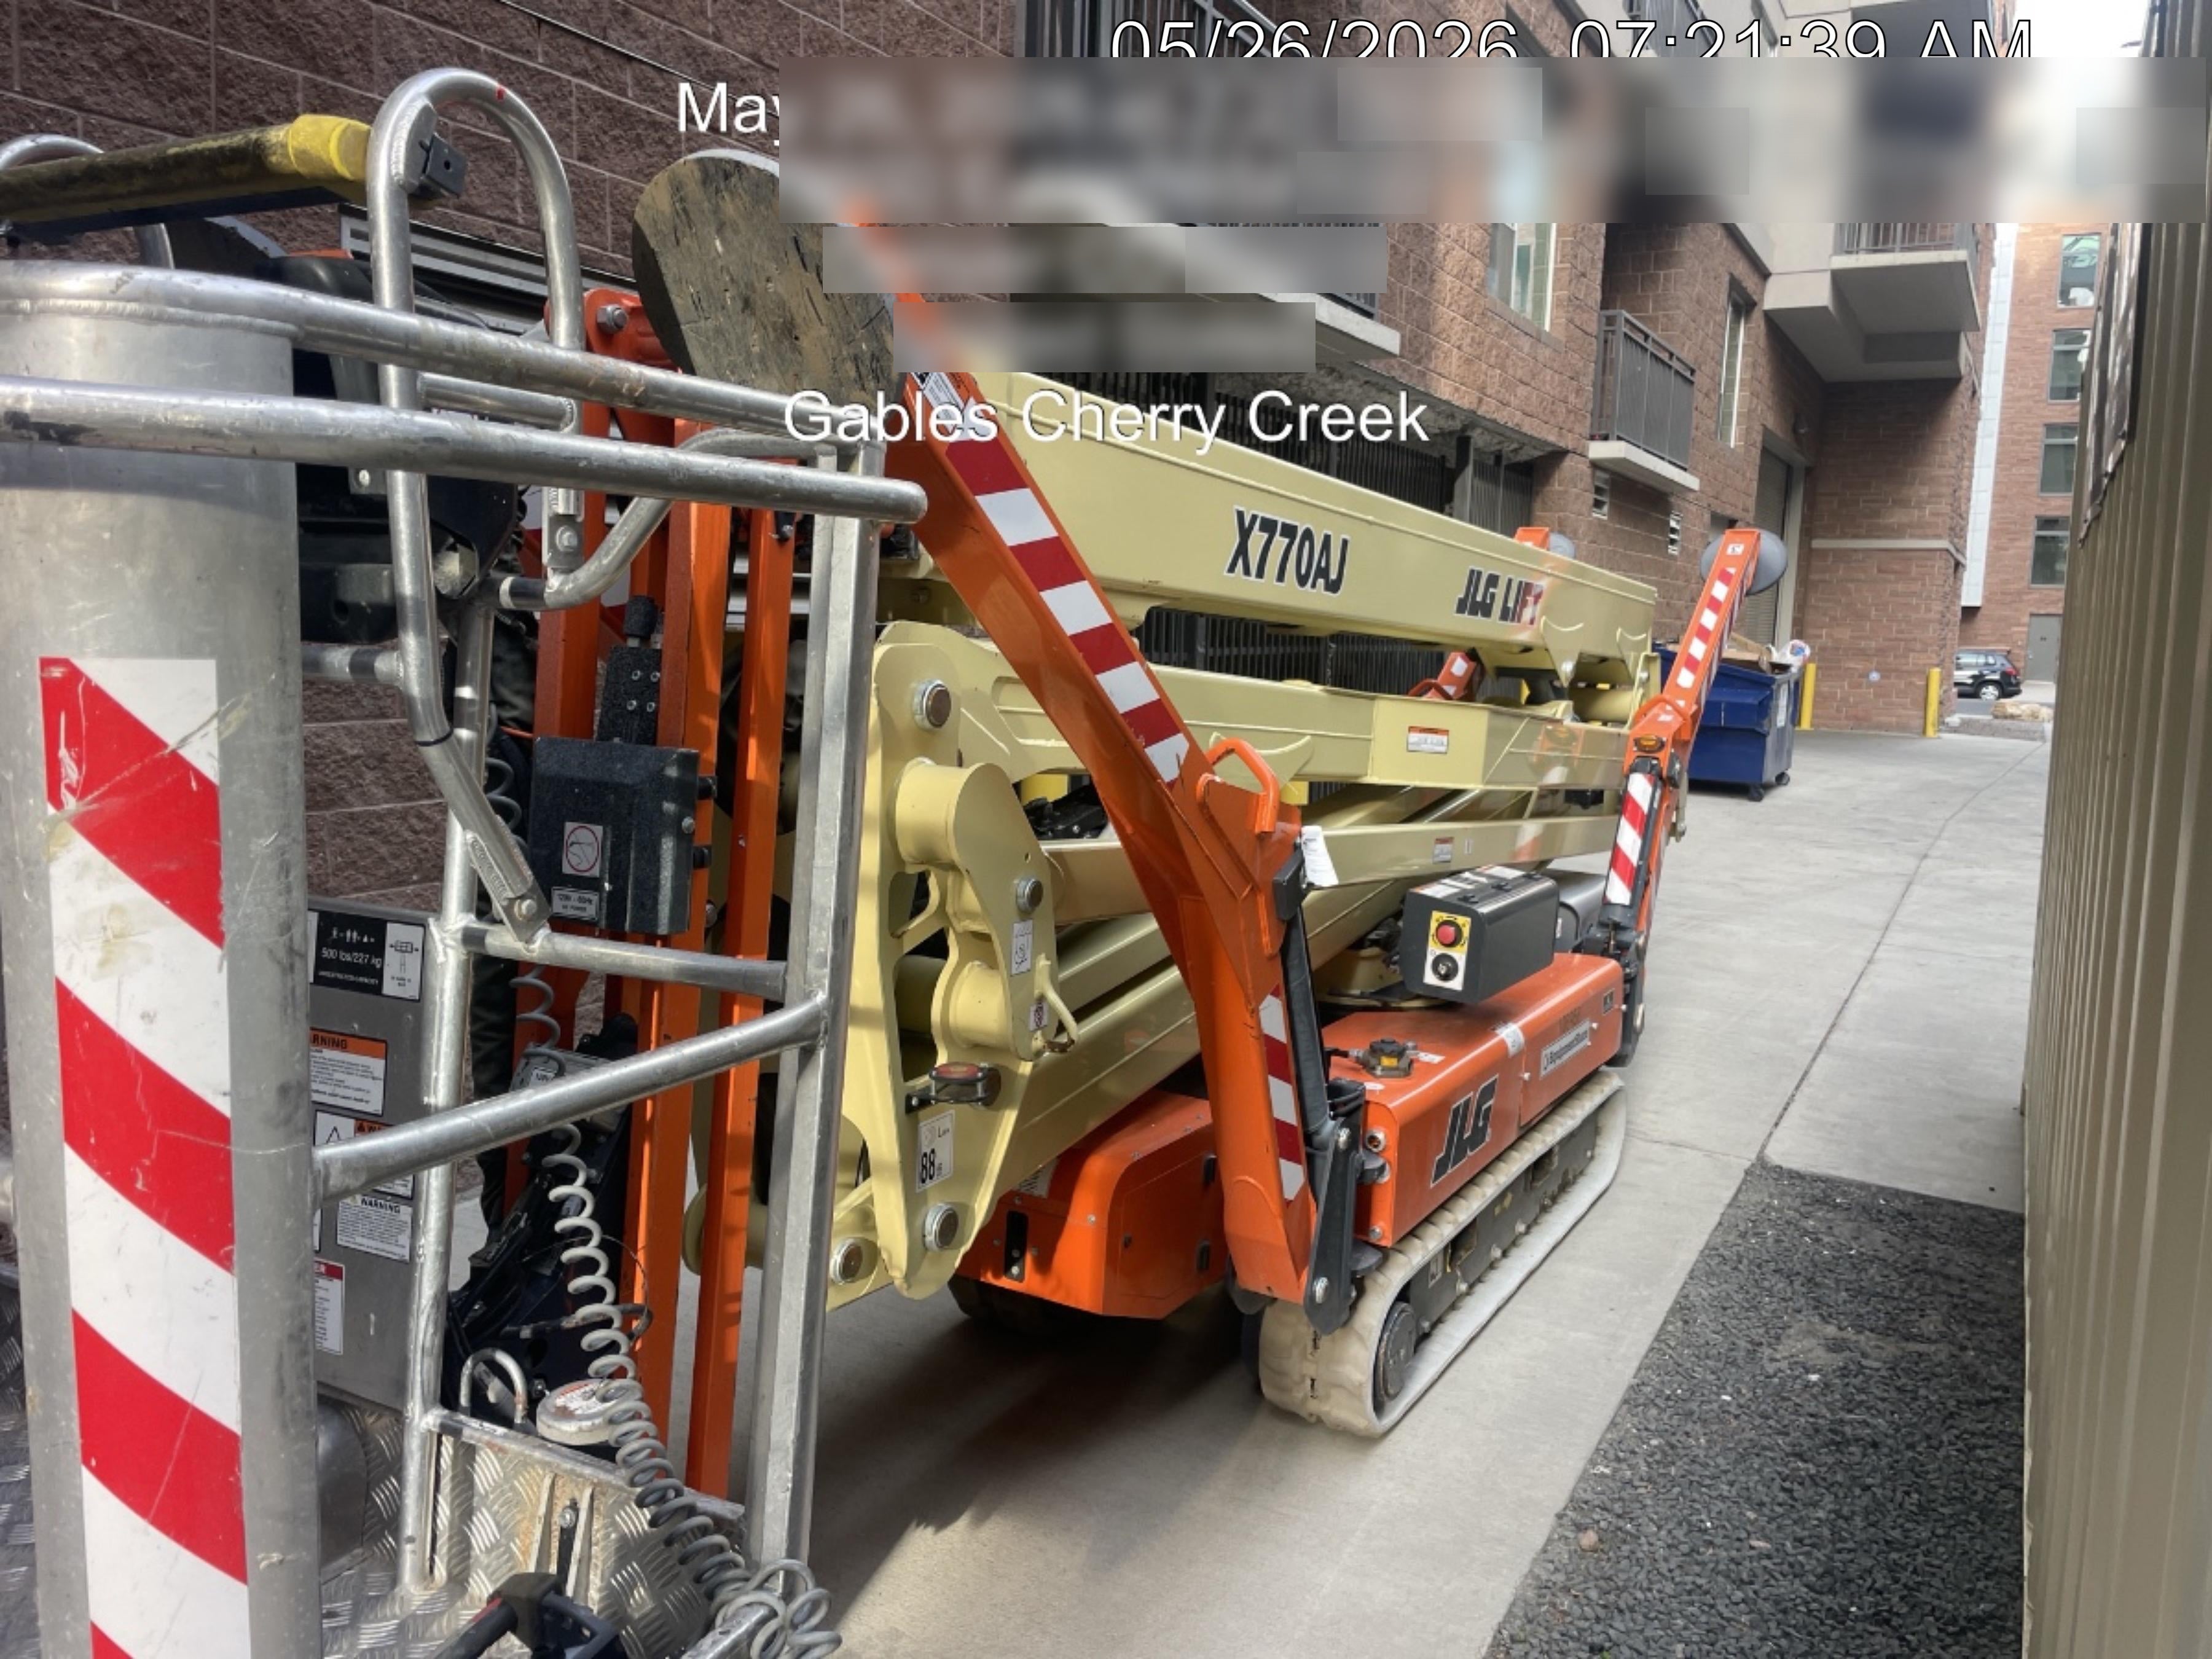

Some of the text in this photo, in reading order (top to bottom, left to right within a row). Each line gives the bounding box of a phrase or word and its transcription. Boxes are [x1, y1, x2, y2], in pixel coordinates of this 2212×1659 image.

[1226, 507, 1350, 595] X770AJ
[1455, 567, 1500, 618] JLG
[310, 1033, 348, 1050] RNING
[1431, 1074, 1499, 1186] JLG
[921, 1147, 936, 1184] 88
[361, 1198, 401, 1214] WARNING
